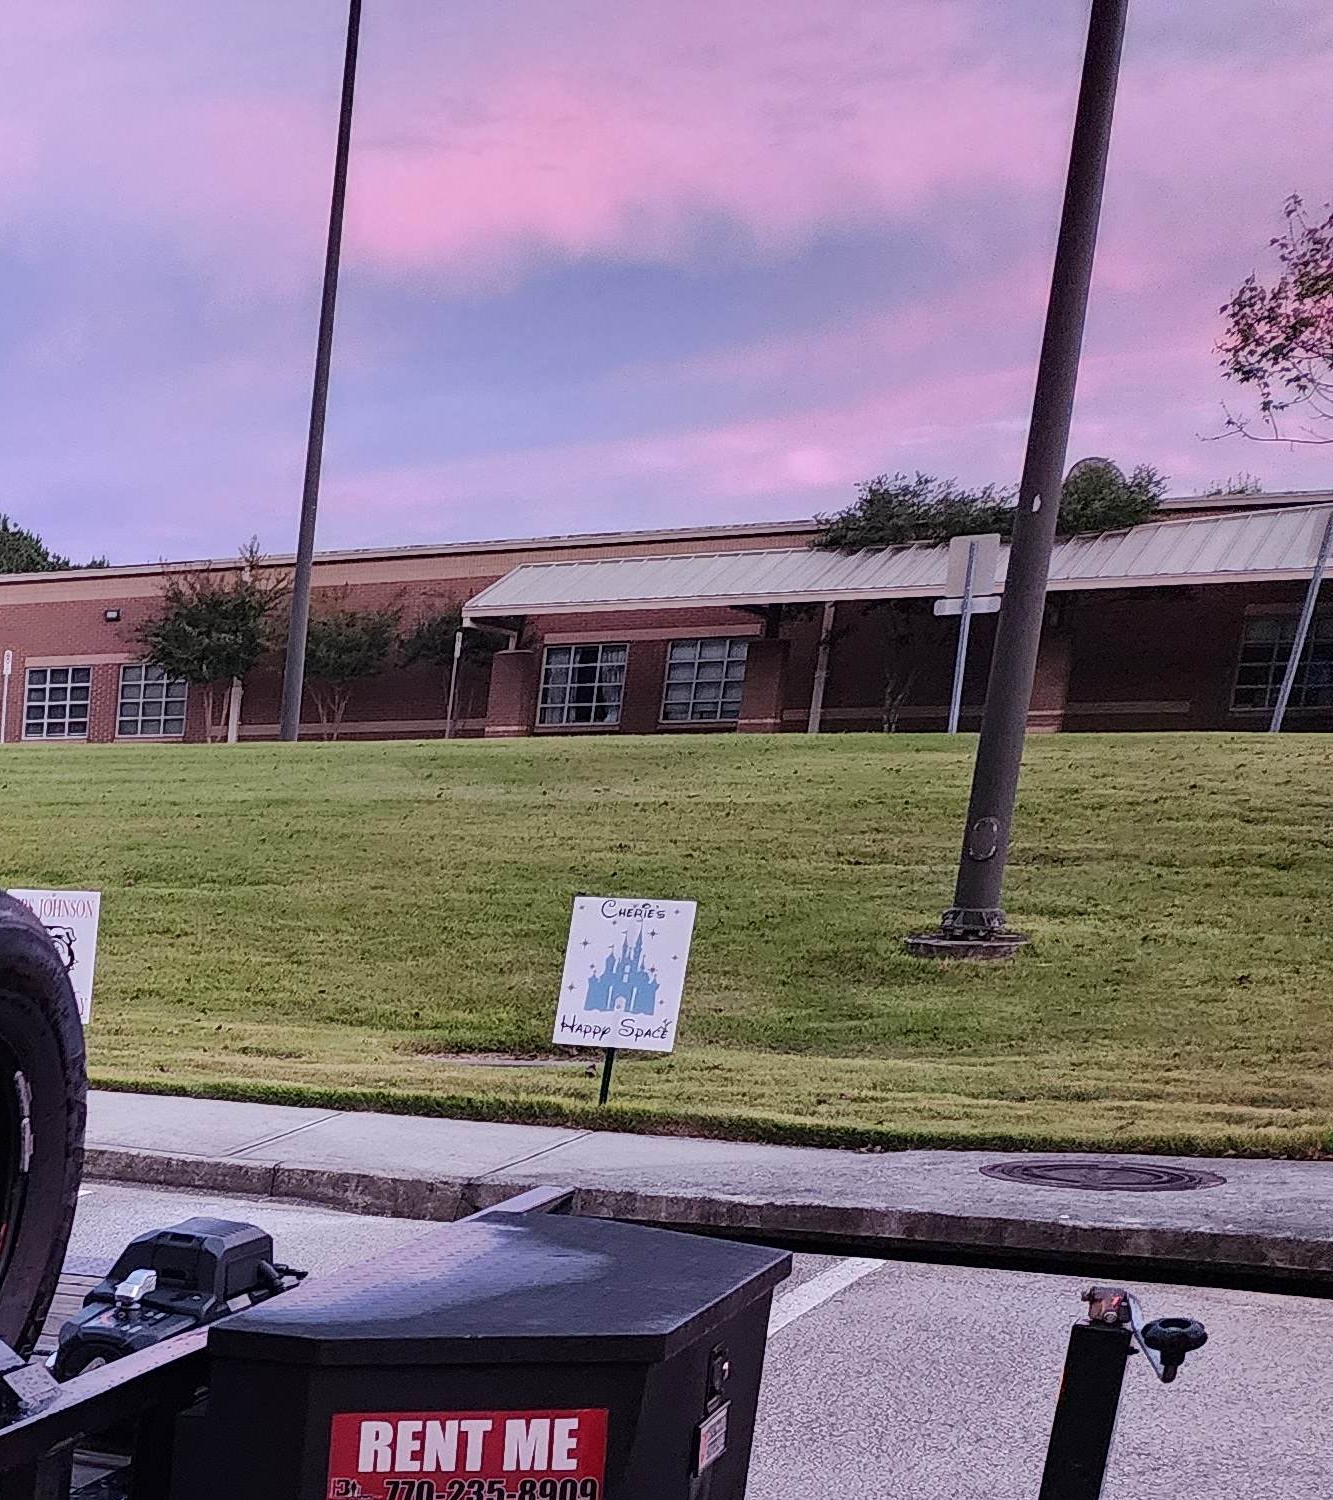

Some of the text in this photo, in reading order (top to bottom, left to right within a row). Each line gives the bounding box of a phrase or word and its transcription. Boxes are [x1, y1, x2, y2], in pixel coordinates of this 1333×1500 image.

[39, 898, 96, 920] JOHNSON
[358, 1418, 579, 1472] RENT ME
